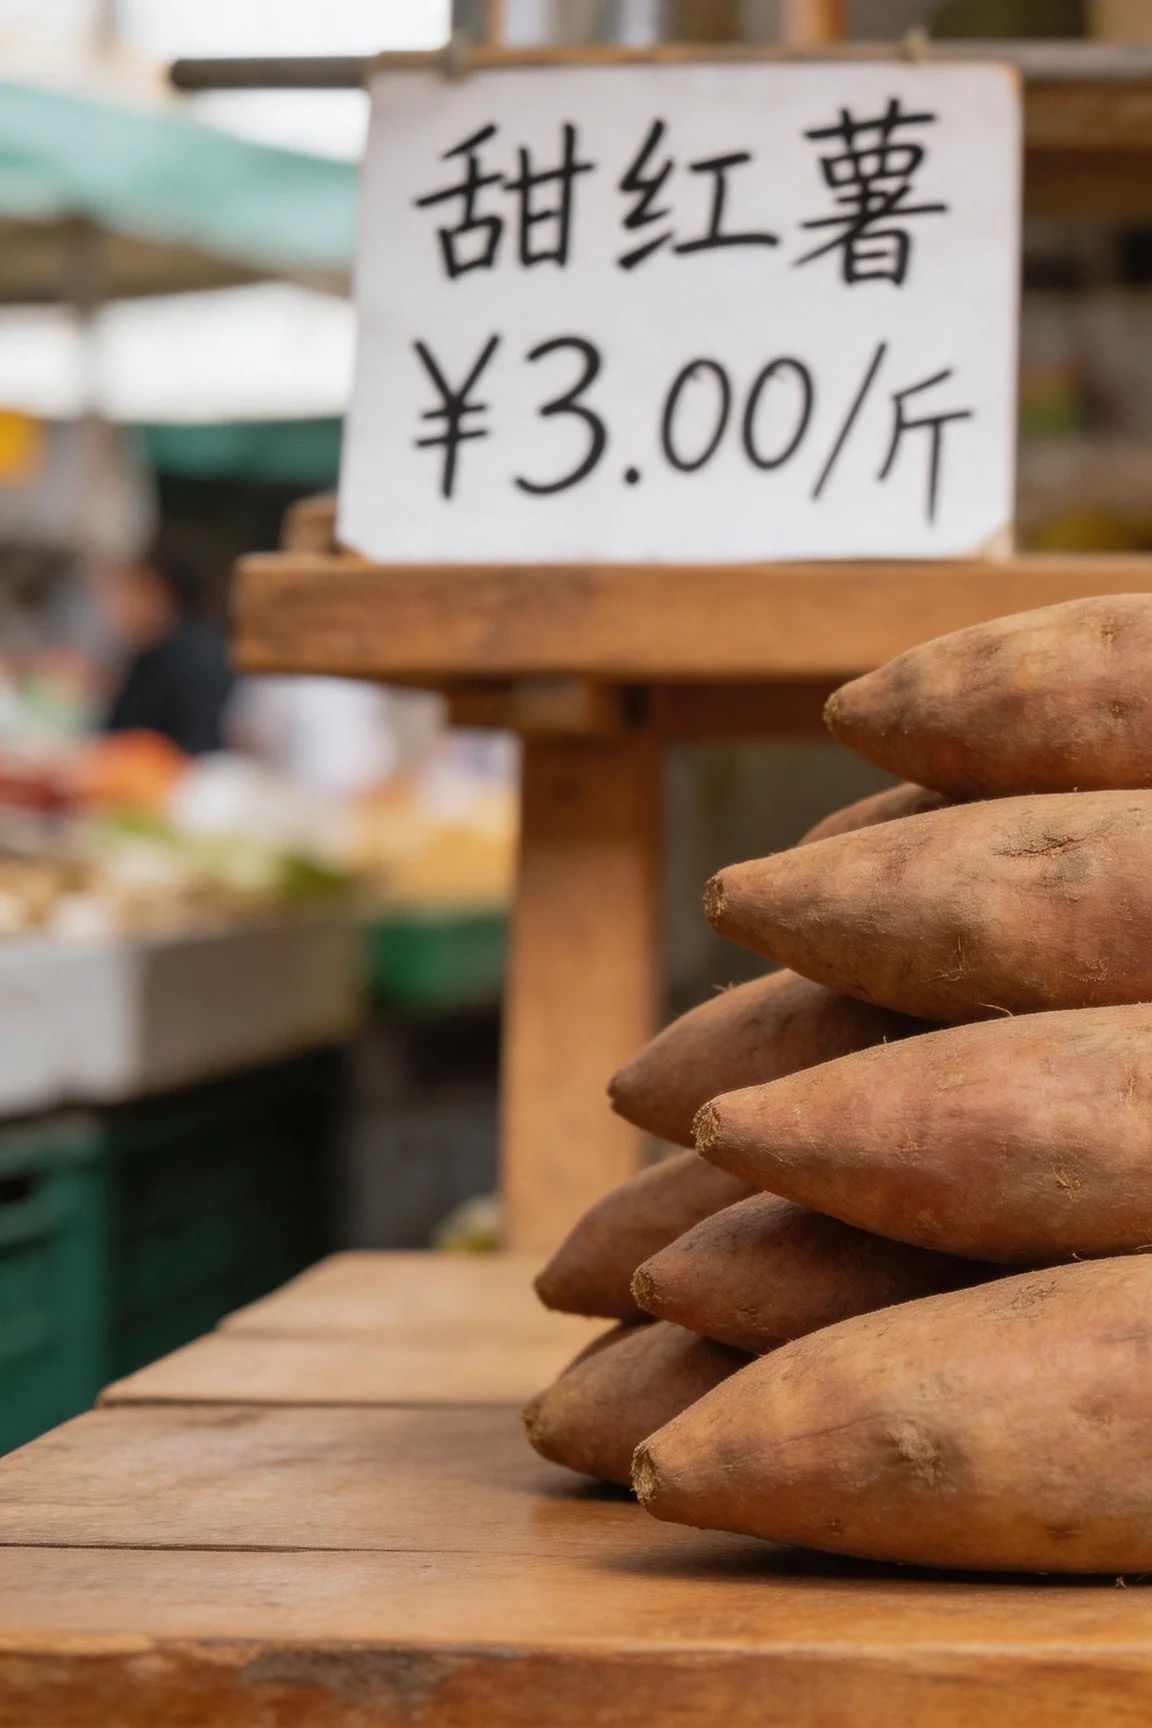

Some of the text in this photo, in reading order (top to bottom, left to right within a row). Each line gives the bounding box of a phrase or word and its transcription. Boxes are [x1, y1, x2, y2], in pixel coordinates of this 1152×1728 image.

[413, 97, 948, 287] 甜红薯
[413, 334, 973, 522] ¥3.00/斤
